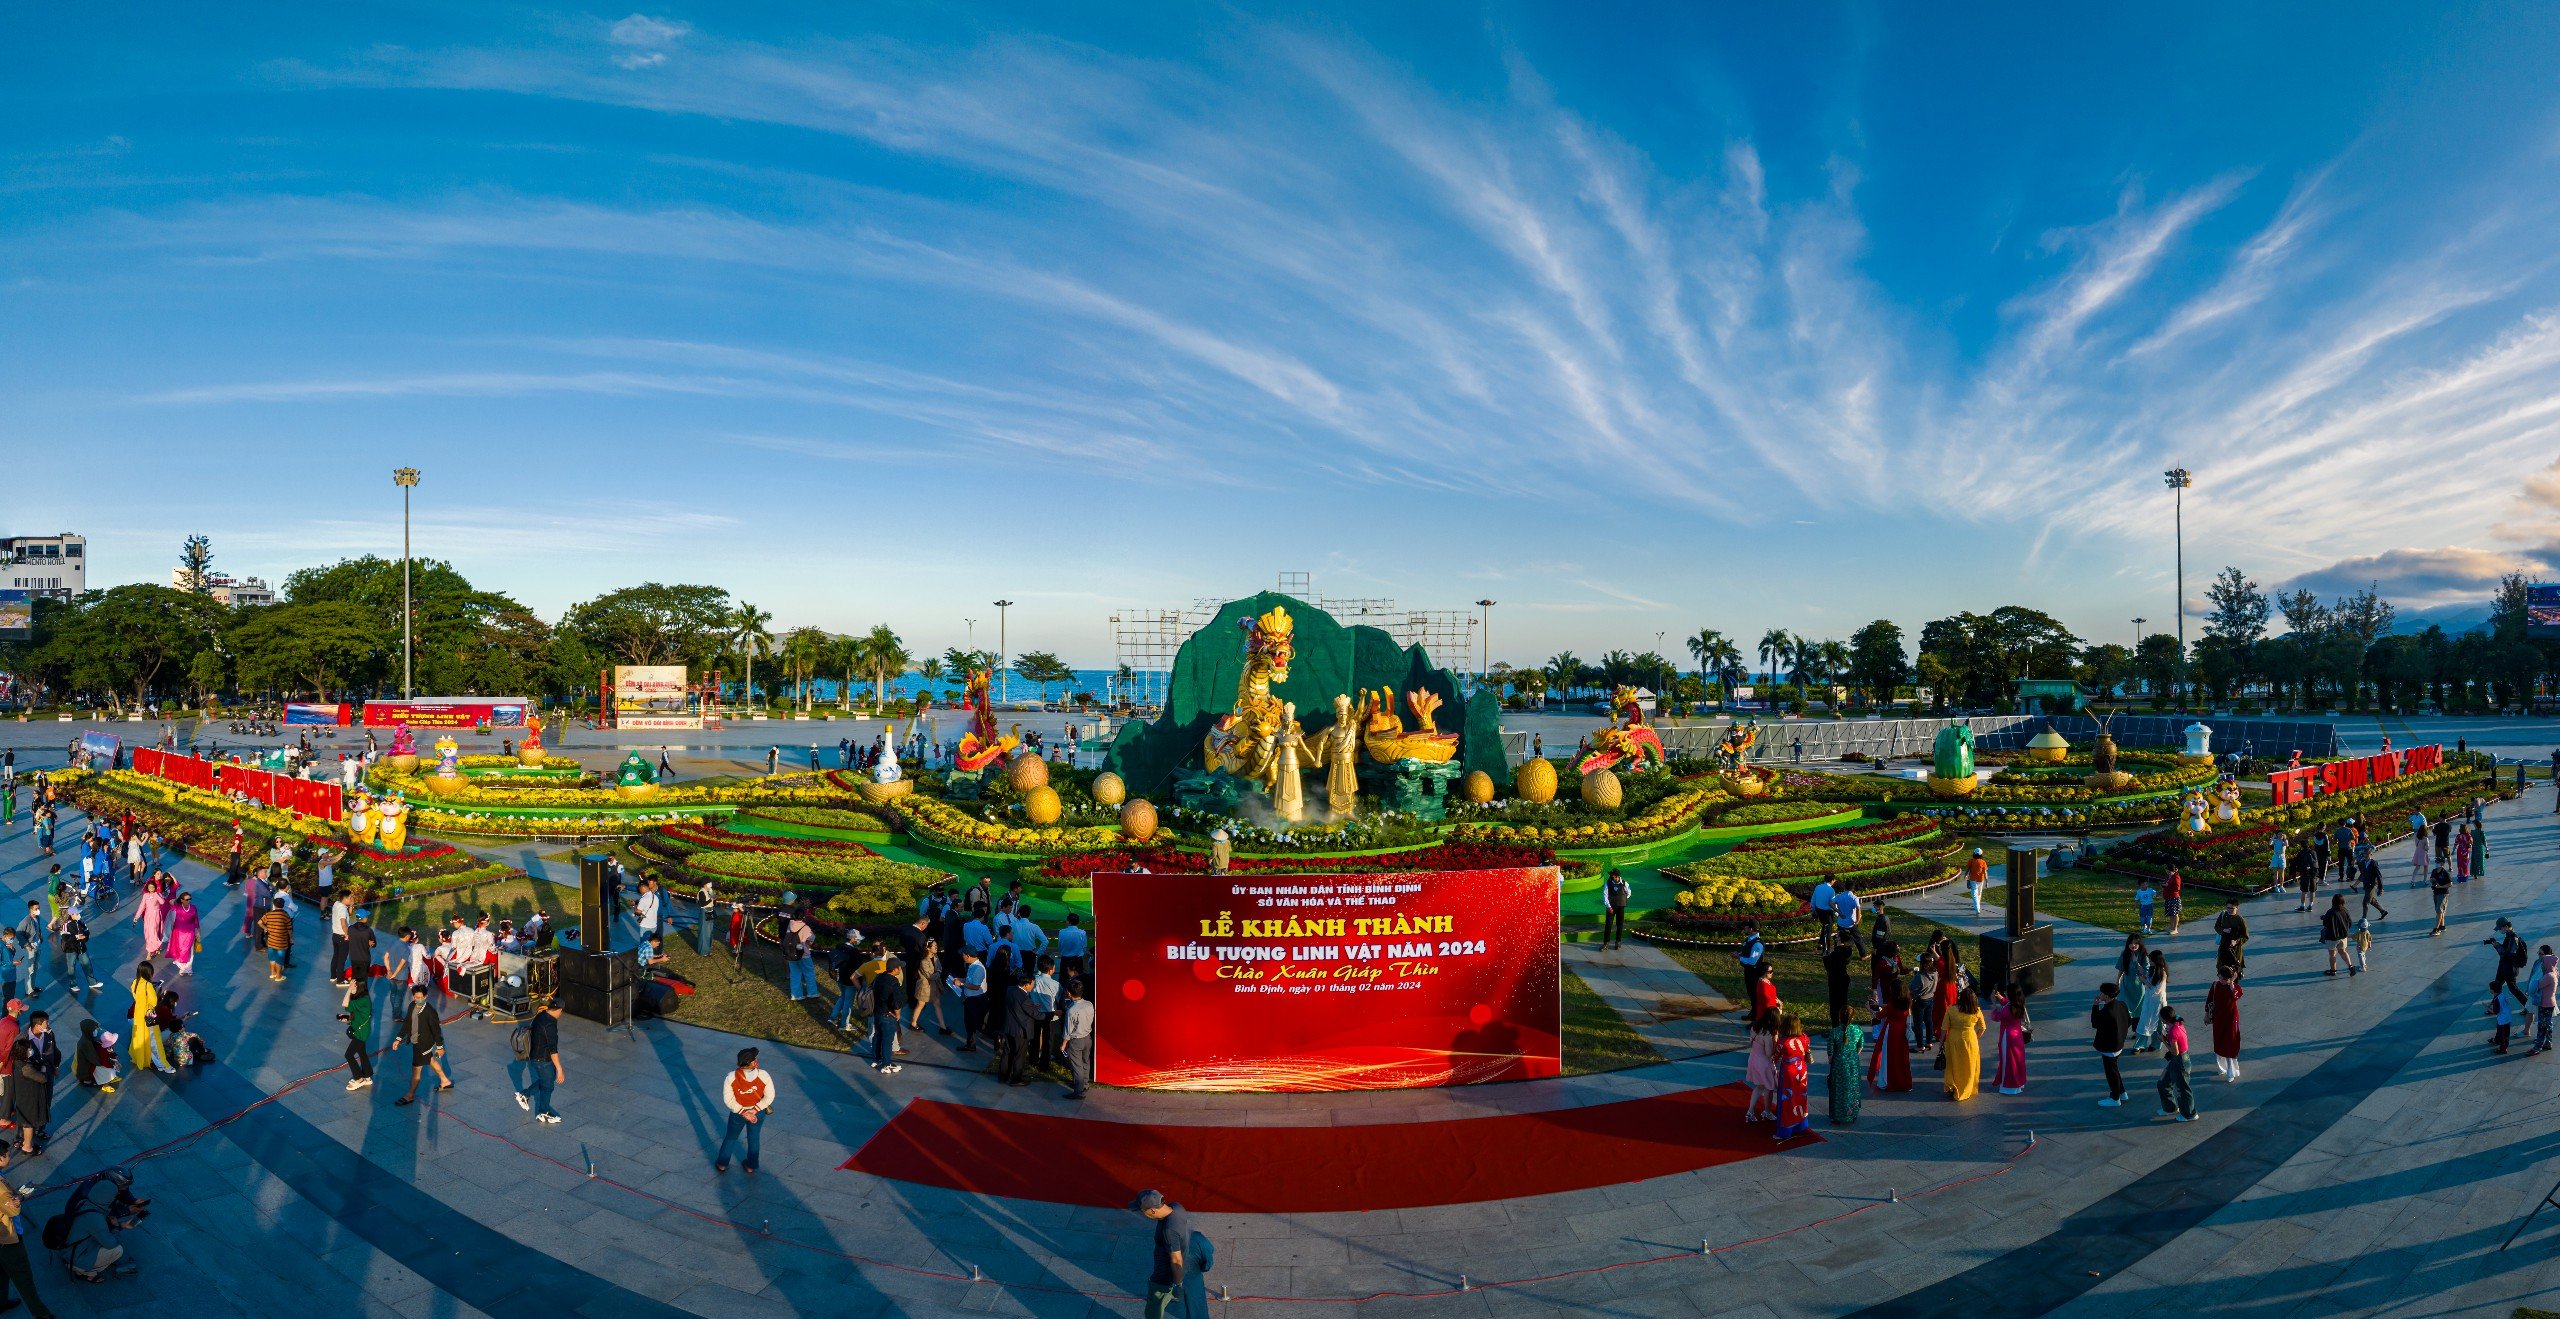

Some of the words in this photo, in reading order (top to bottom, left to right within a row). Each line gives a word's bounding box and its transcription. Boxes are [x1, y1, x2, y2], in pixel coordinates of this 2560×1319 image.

[2267, 750, 2318, 806] TẾT
[2319, 758, 2368, 795] SUM
[2369, 737, 2402, 783] VẦY
[2404, 744, 2443, 775] 2024
[1231, 884, 1247, 895] ỦY
[1249, 886, 1273, 895] BAN
[1275, 885, 1308, 895] NHÂN
[1310, 885, 1334, 894] DÂN
[1336, 884, 1362, 894] TỈNH
[1364, 884, 1392, 893] BÌNH
[1394, 884, 1422, 893] ĐỊNH
[1258, 897, 1273, 907] SỞ
[1276, 898, 1299, 907] VĂN
[1301, 897, 1325, 906] HÓA
[1327, 897, 1342, 906] VÀ
[1345, 895, 1365, 905] THỂ
[1368, 896, 1396, 905] THAO
[1200, 911, 1234, 937] LỄ
[1241, 914, 1346, 938] KHÁNH
[1353, 912, 1453, 936] THÀNH
[1166, 941, 1210, 960] BIỂU
[1216, 946, 1286, 964] TƯỢNG
[1292, 945, 1338, 960] LINH
[1344, 942, 1381, 962] VẬT
[1388, 941, 1433, 959] NĂM
[1439, 940, 1486, 957] 2024
[1215, 965, 1264, 980] Chào
[1271, 964, 1327, 981] Xuân
[1333, 964, 1382, 982] Giáp
[1388, 961, 1439, 977] Thìn
[1234, 984, 1257, 993] Bình
[1259, 984, 1286, 995] Định,
[1288, 984, 1312, 995] ngày
[1314, 984, 1326, 992] 01
[1329, 983, 1356, 993] tháng
[1359, 983, 1371, 991] 02
[1373, 982, 1394, 991] năm
[1397, 981, 1422, 990] 2024
